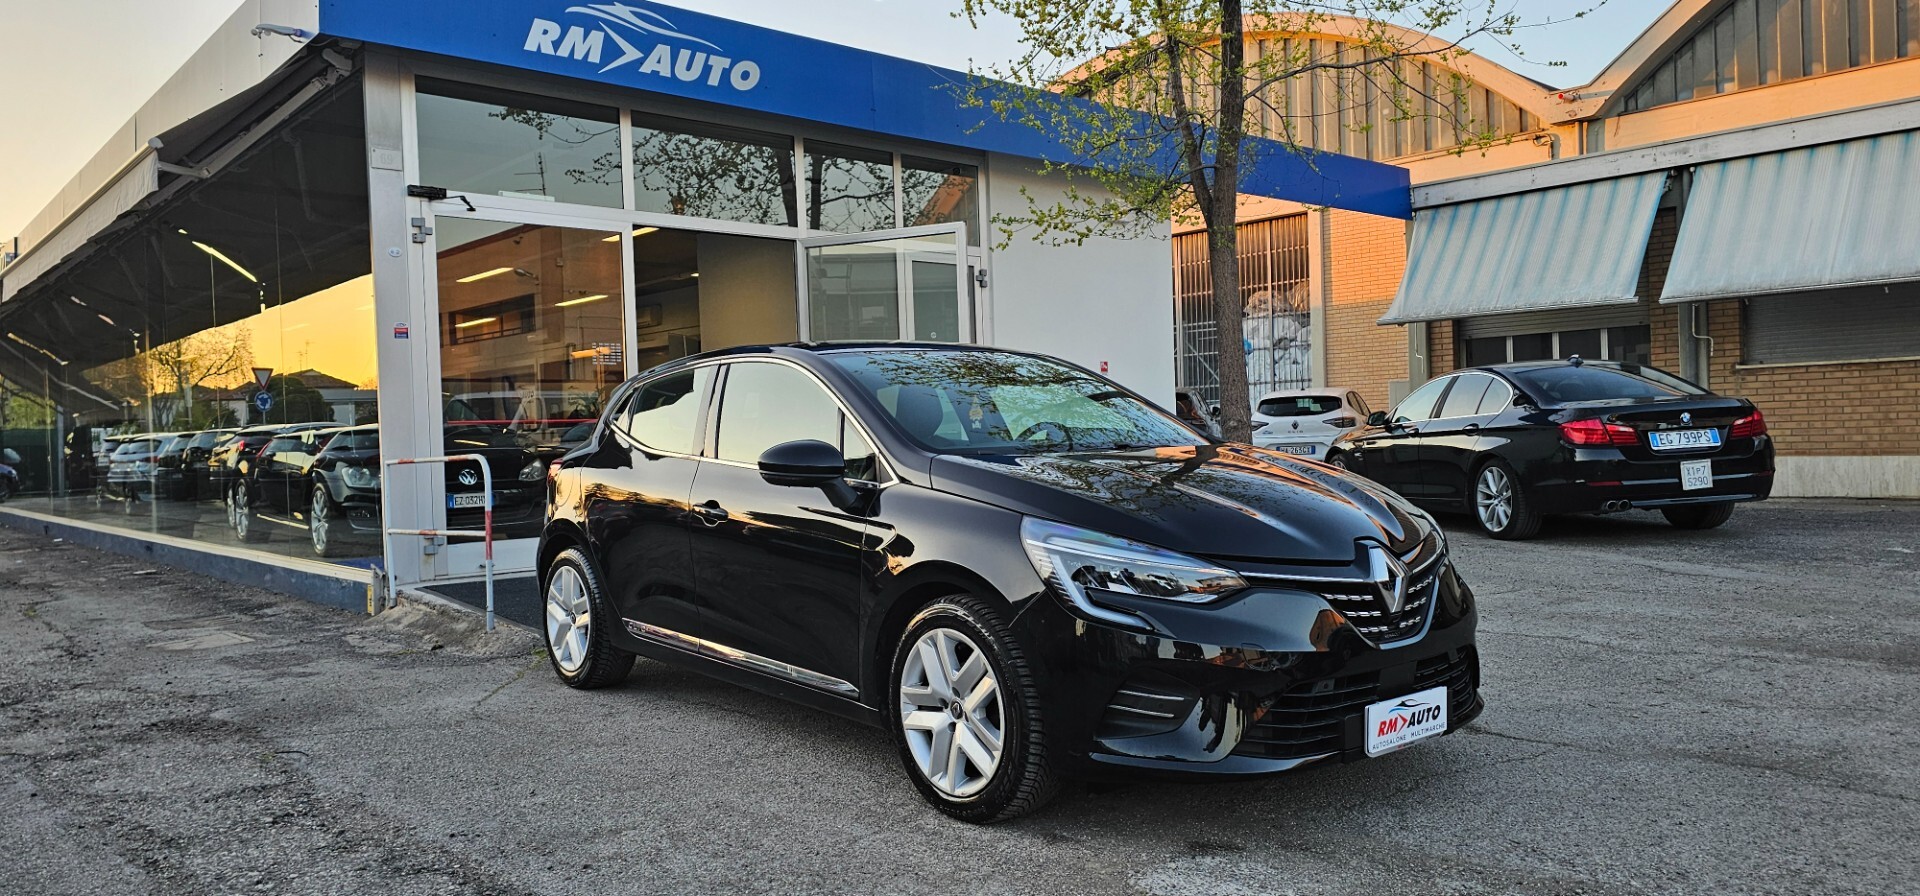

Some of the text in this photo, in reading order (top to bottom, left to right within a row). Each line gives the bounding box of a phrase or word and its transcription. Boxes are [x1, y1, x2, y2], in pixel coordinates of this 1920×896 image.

[523, 17, 761, 91] RM AUTO
[1658, 431, 1711, 445] EG 799PS
[1687, 476, 1709, 487] 5290
[1372, 734, 1406, 751] AUTOSALONE
[1410, 721, 1446, 738] MULTIMARCHE
[1377, 704, 1441, 738] RM AUTO
